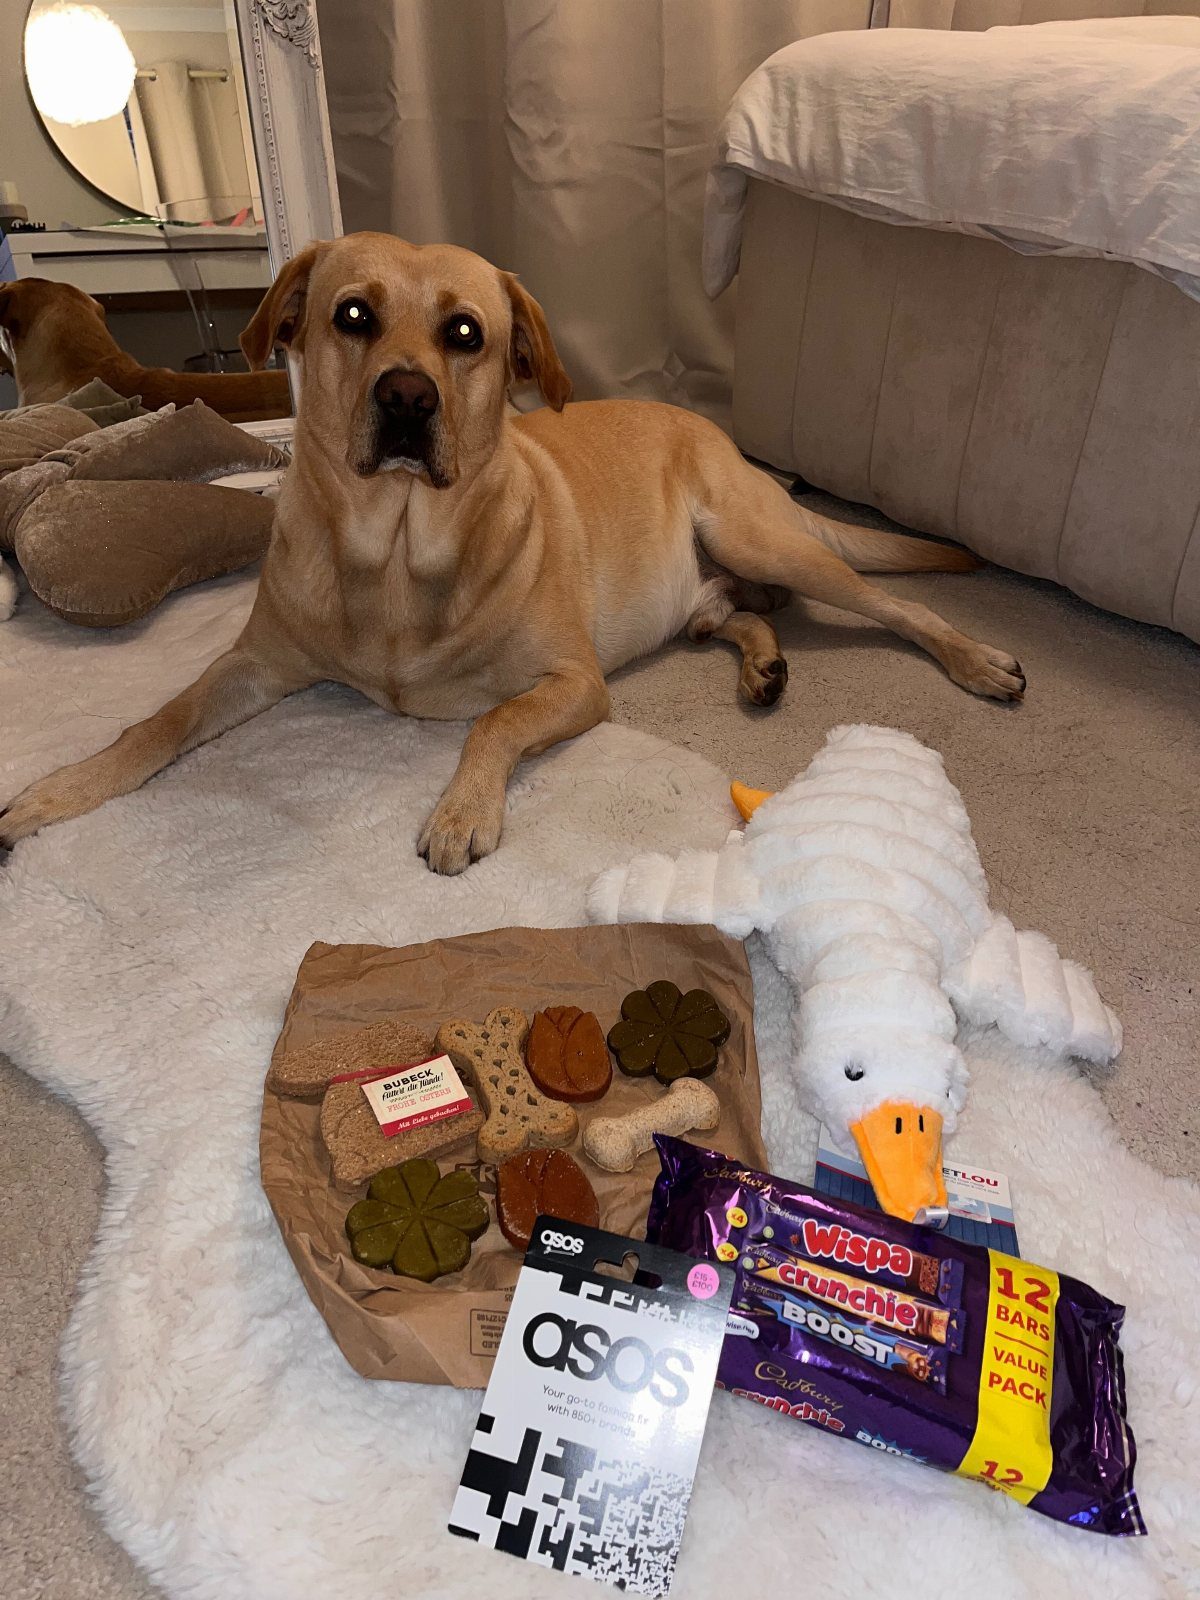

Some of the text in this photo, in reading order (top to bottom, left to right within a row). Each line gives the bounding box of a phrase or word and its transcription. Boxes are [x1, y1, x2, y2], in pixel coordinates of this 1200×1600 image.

[383, 1069, 434, 1091] BUBECK
[386, 1087, 452, 1113] FROHE OSTERN
[412, 1115, 428, 1125] Liebe
[942, 1167, 999, 1187] ETLOU
[731, 1213, 744, 1224] x4
[765, 1203, 805, 1227] Cadbury
[803, 1218, 914, 1277] Wispa
[692, 1280, 713, 1293] £100
[693, 1271, 708, 1282] £15
[995, 1267, 1051, 1315] 12
[778, 1262, 919, 1328] crunchie
[783, 1299, 894, 1364] BOOST
[996, 1304, 1050, 1342] BARS
[993, 1346, 1048, 1382] VALUE
[543, 1384, 566, 1399] Your
[566, 1394, 596, 1410] go-to
[598, 1402, 635, 1423] fashion
[755, 1361, 845, 1412] Cadbury
[988, 1371, 1048, 1410] PACK
[547, 1403, 637, 1439] with 850+ brands
